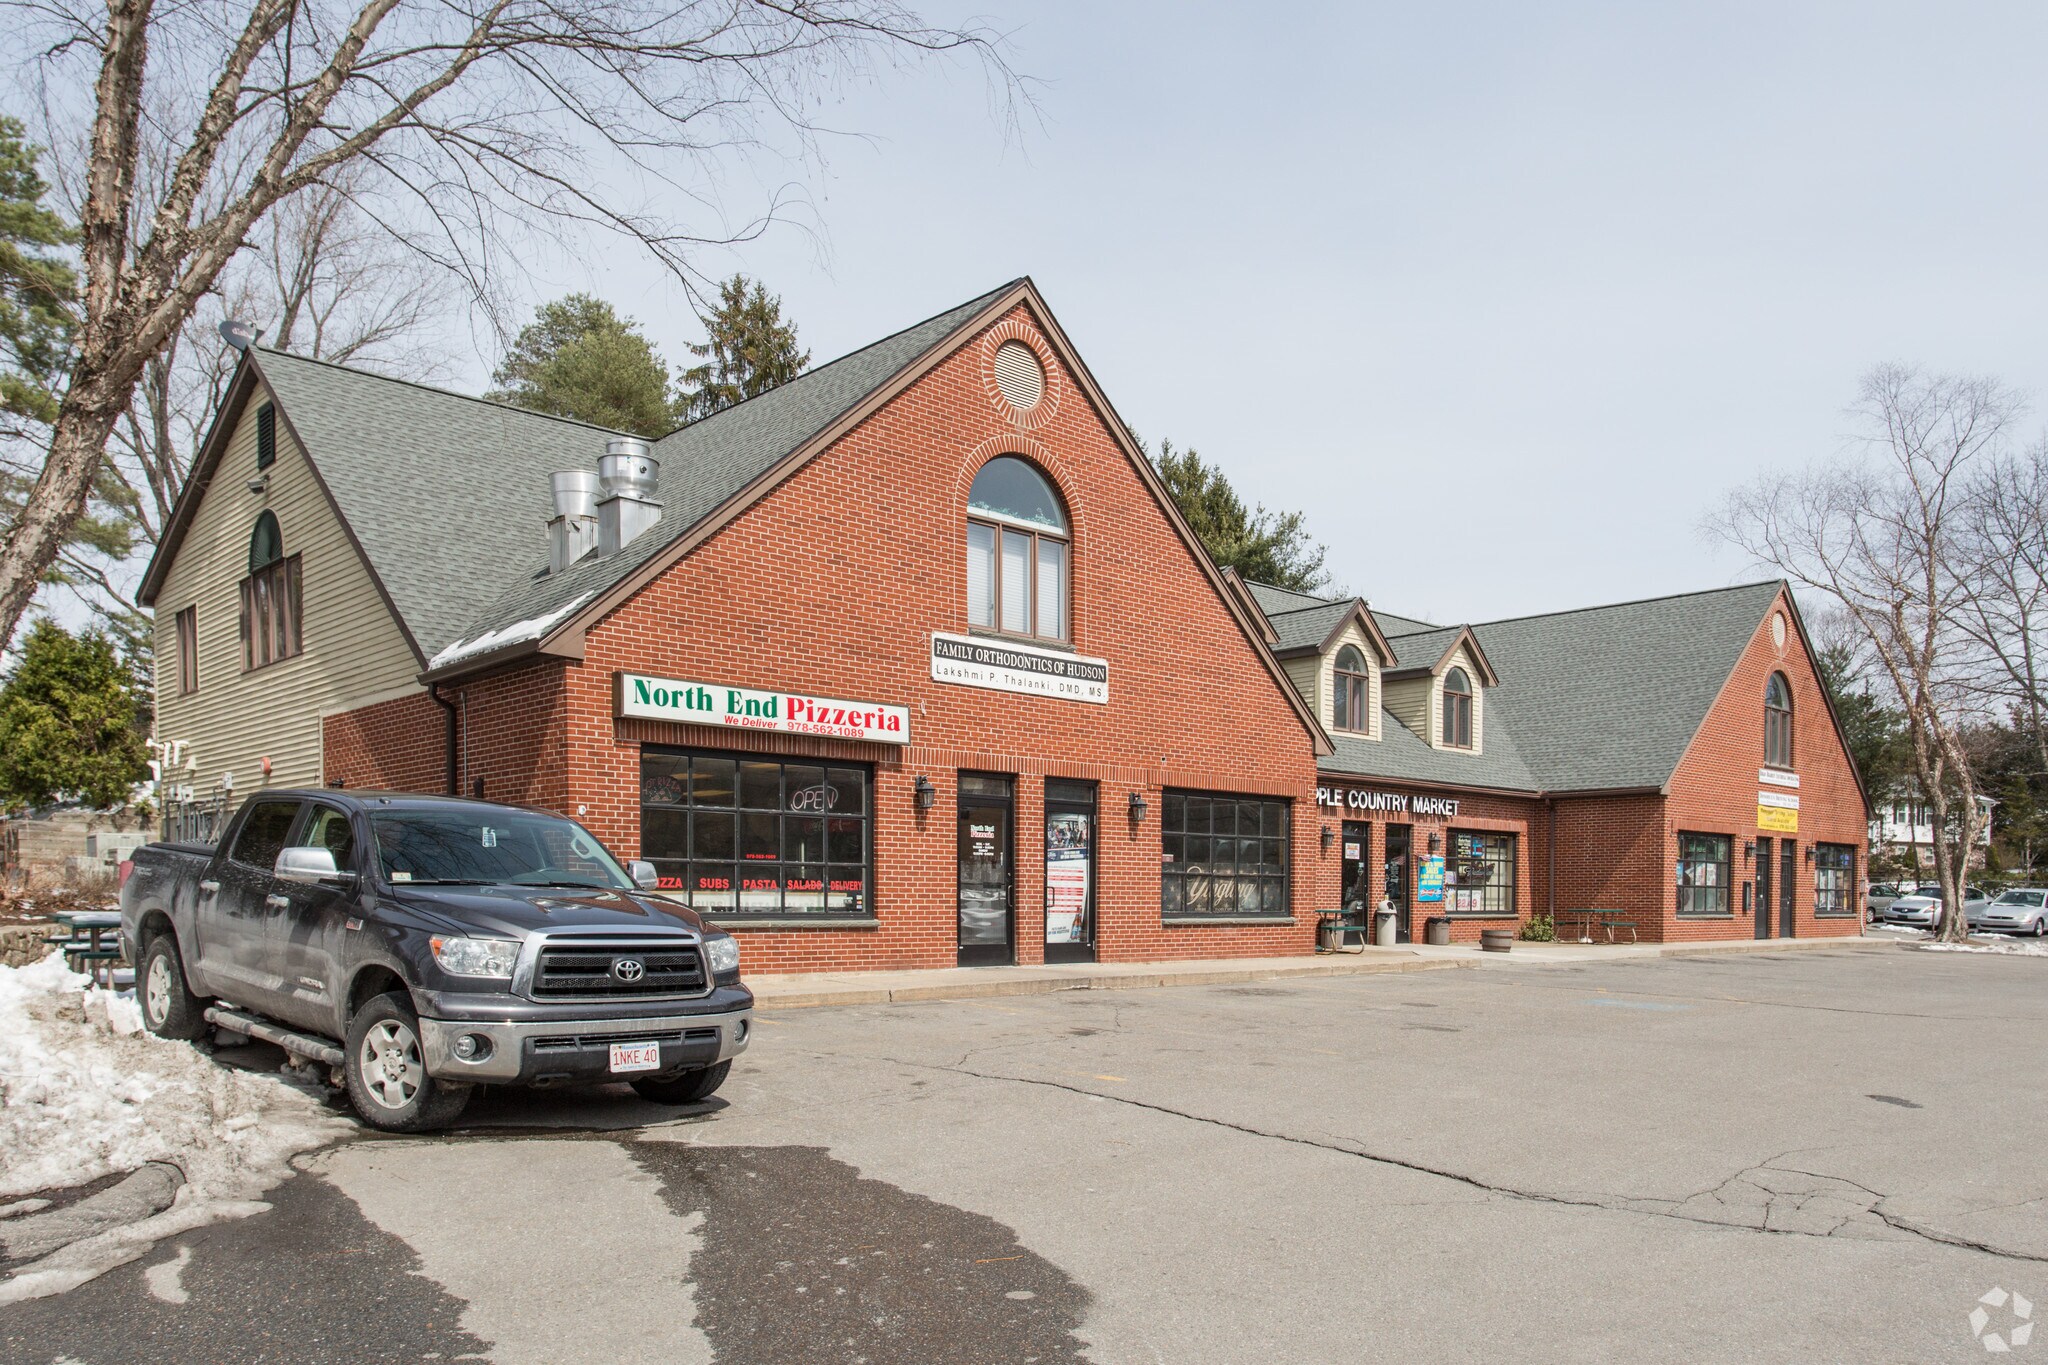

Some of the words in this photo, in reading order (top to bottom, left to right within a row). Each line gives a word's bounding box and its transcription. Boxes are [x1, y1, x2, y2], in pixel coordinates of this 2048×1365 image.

[936, 641, 973, 660] FAMILY
[975, 649, 1052, 673] ORTHODONTICS
[1054, 661, 1065, 674] OF
[1067, 663, 1105, 681] HUDSON
[936, 665, 983, 681] Lakshmi
[989, 672, 999, 683] P.
[634, 679, 713, 712] North
[726, 690, 778, 719] End
[786, 697, 901, 732] Pizzeria
[724, 715, 739, 725] We
[742, 716, 778, 729] Deliver
[787, 722, 865, 738] 978-562-1089
[793, 790, 834, 809] OPEN
[1348, 790, 1408, 812] COUNTRY
[1413, 796, 1460, 816] MARKET
[656, 877, 683, 889] IZZA
[699, 877, 730, 890] SUBS
[743, 879, 778, 891] PASTA
[787, 879, 823, 891] SALADS
[830, 880, 863, 892] DELIVERY
[613, 1050, 641, 1066] 1NKE
[644, 1049, 657, 1062] 40
